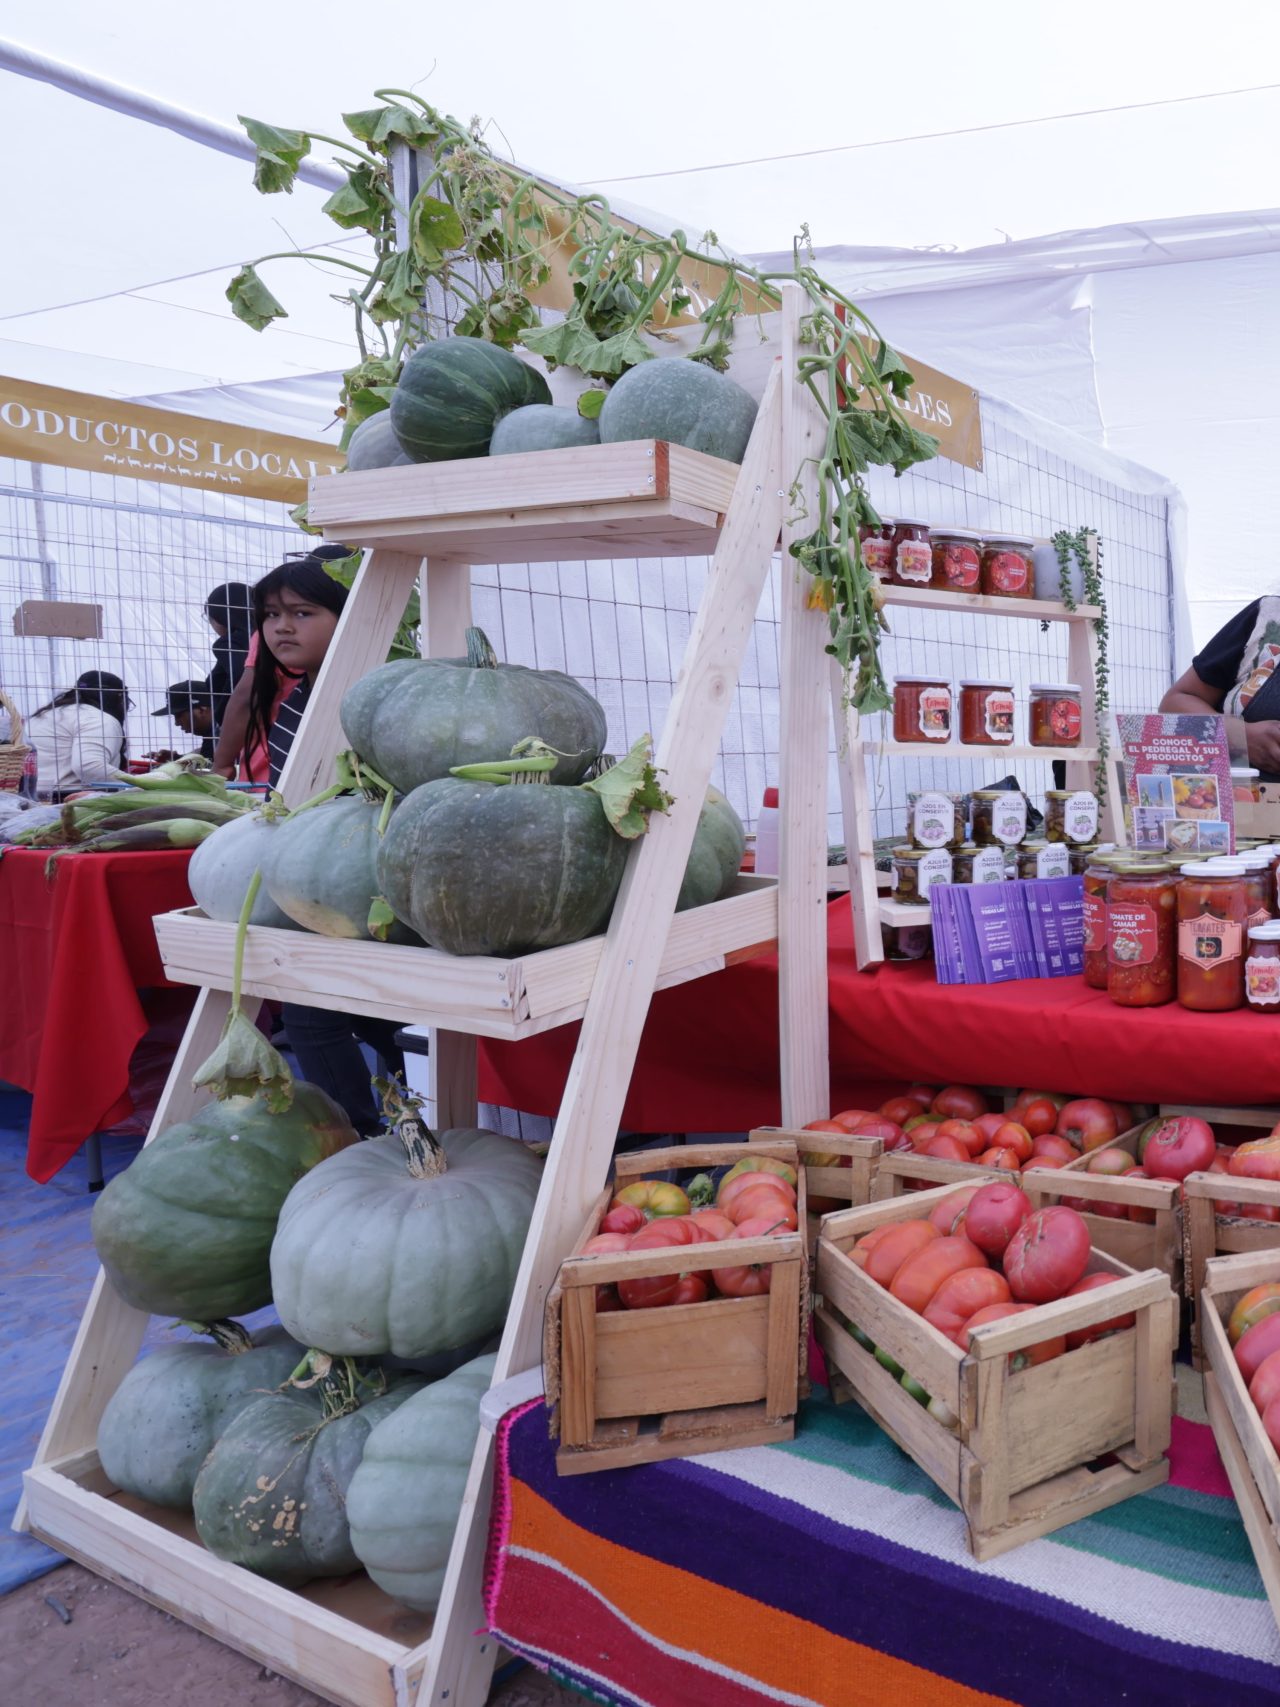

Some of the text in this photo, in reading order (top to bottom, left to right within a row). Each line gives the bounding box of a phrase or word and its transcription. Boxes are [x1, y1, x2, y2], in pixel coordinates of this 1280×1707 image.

[1152, 738, 1194, 747] CONOCE
[1128, 745, 1220, 755] EL PEDREGAL Y SUS
[1145, 753, 1205, 762] PRODUCTOS
[1135, 913, 1147, 921] DE
